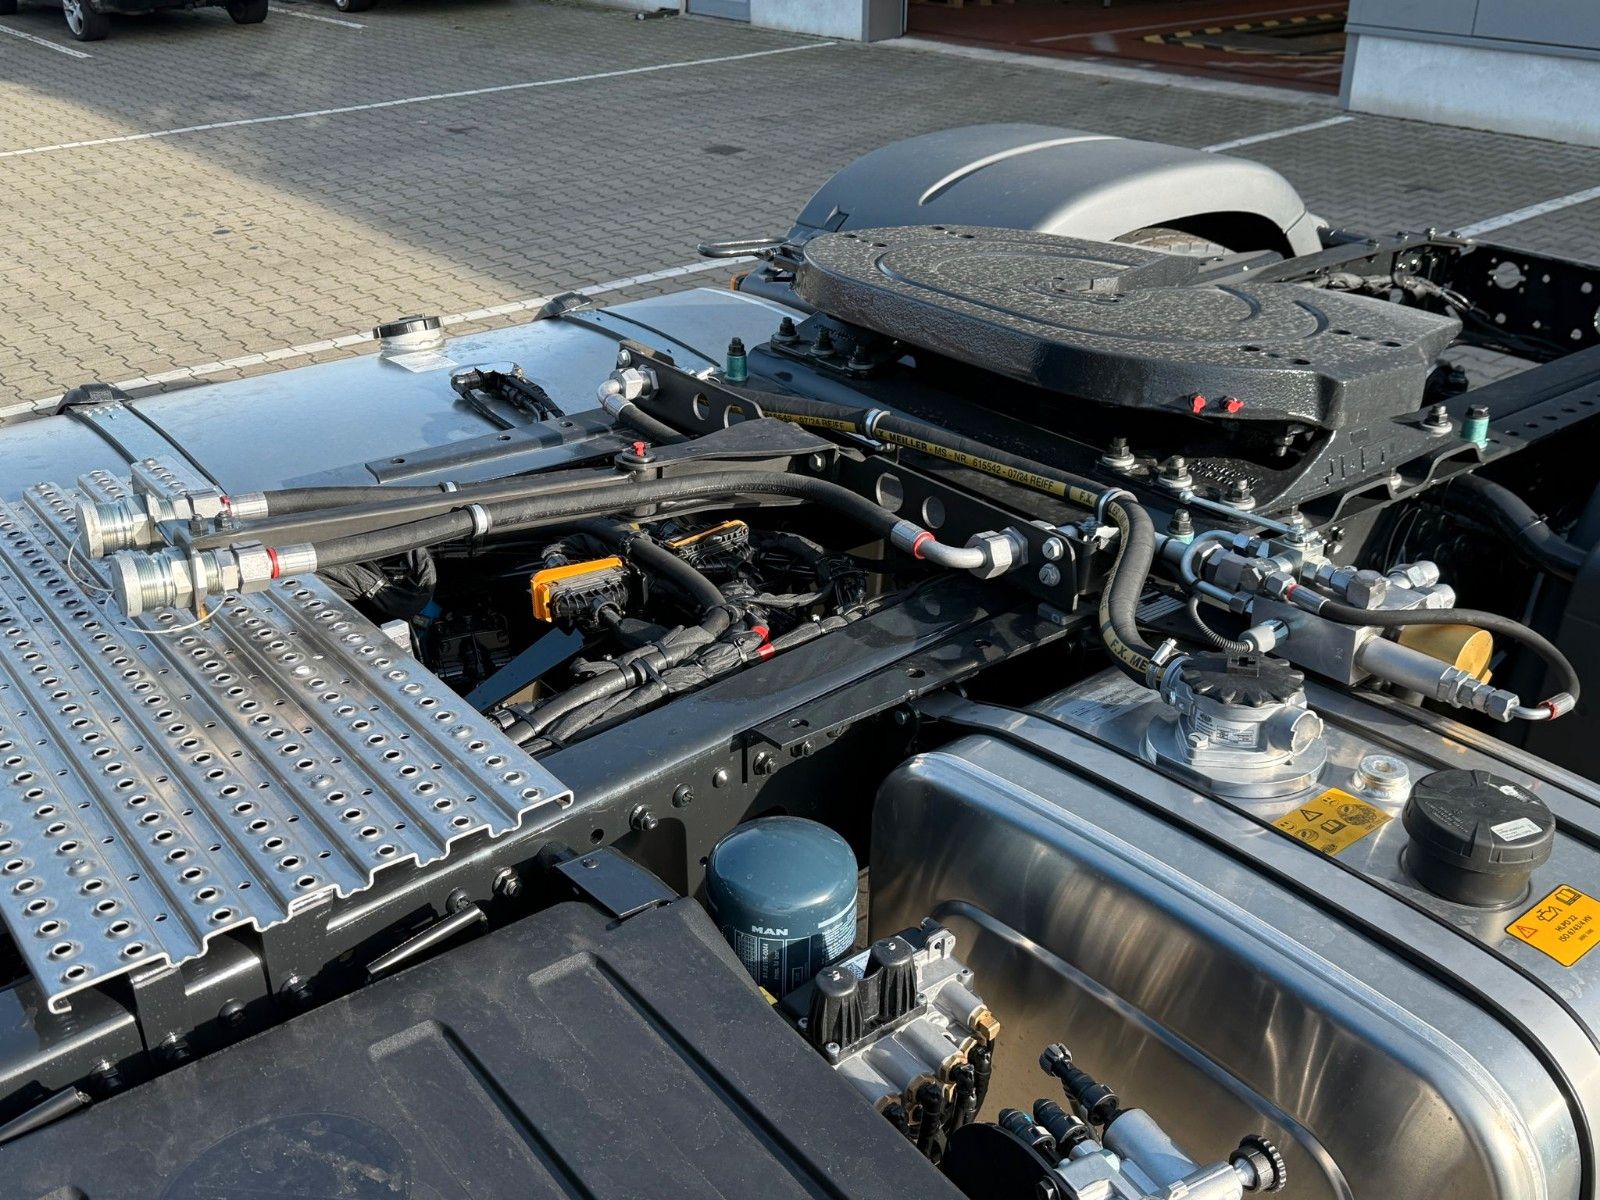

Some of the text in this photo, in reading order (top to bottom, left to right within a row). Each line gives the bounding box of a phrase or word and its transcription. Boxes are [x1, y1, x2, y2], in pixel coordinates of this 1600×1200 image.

[889, 432, 928, 452] MEILLER
[934, 446, 947, 457] MS
[972, 458, 1001, 474] 615542
[1007, 466, 1029, 481] 07/24
[1030, 474, 1054, 491] REIFF
[752, 925, 789, 936] MAN
